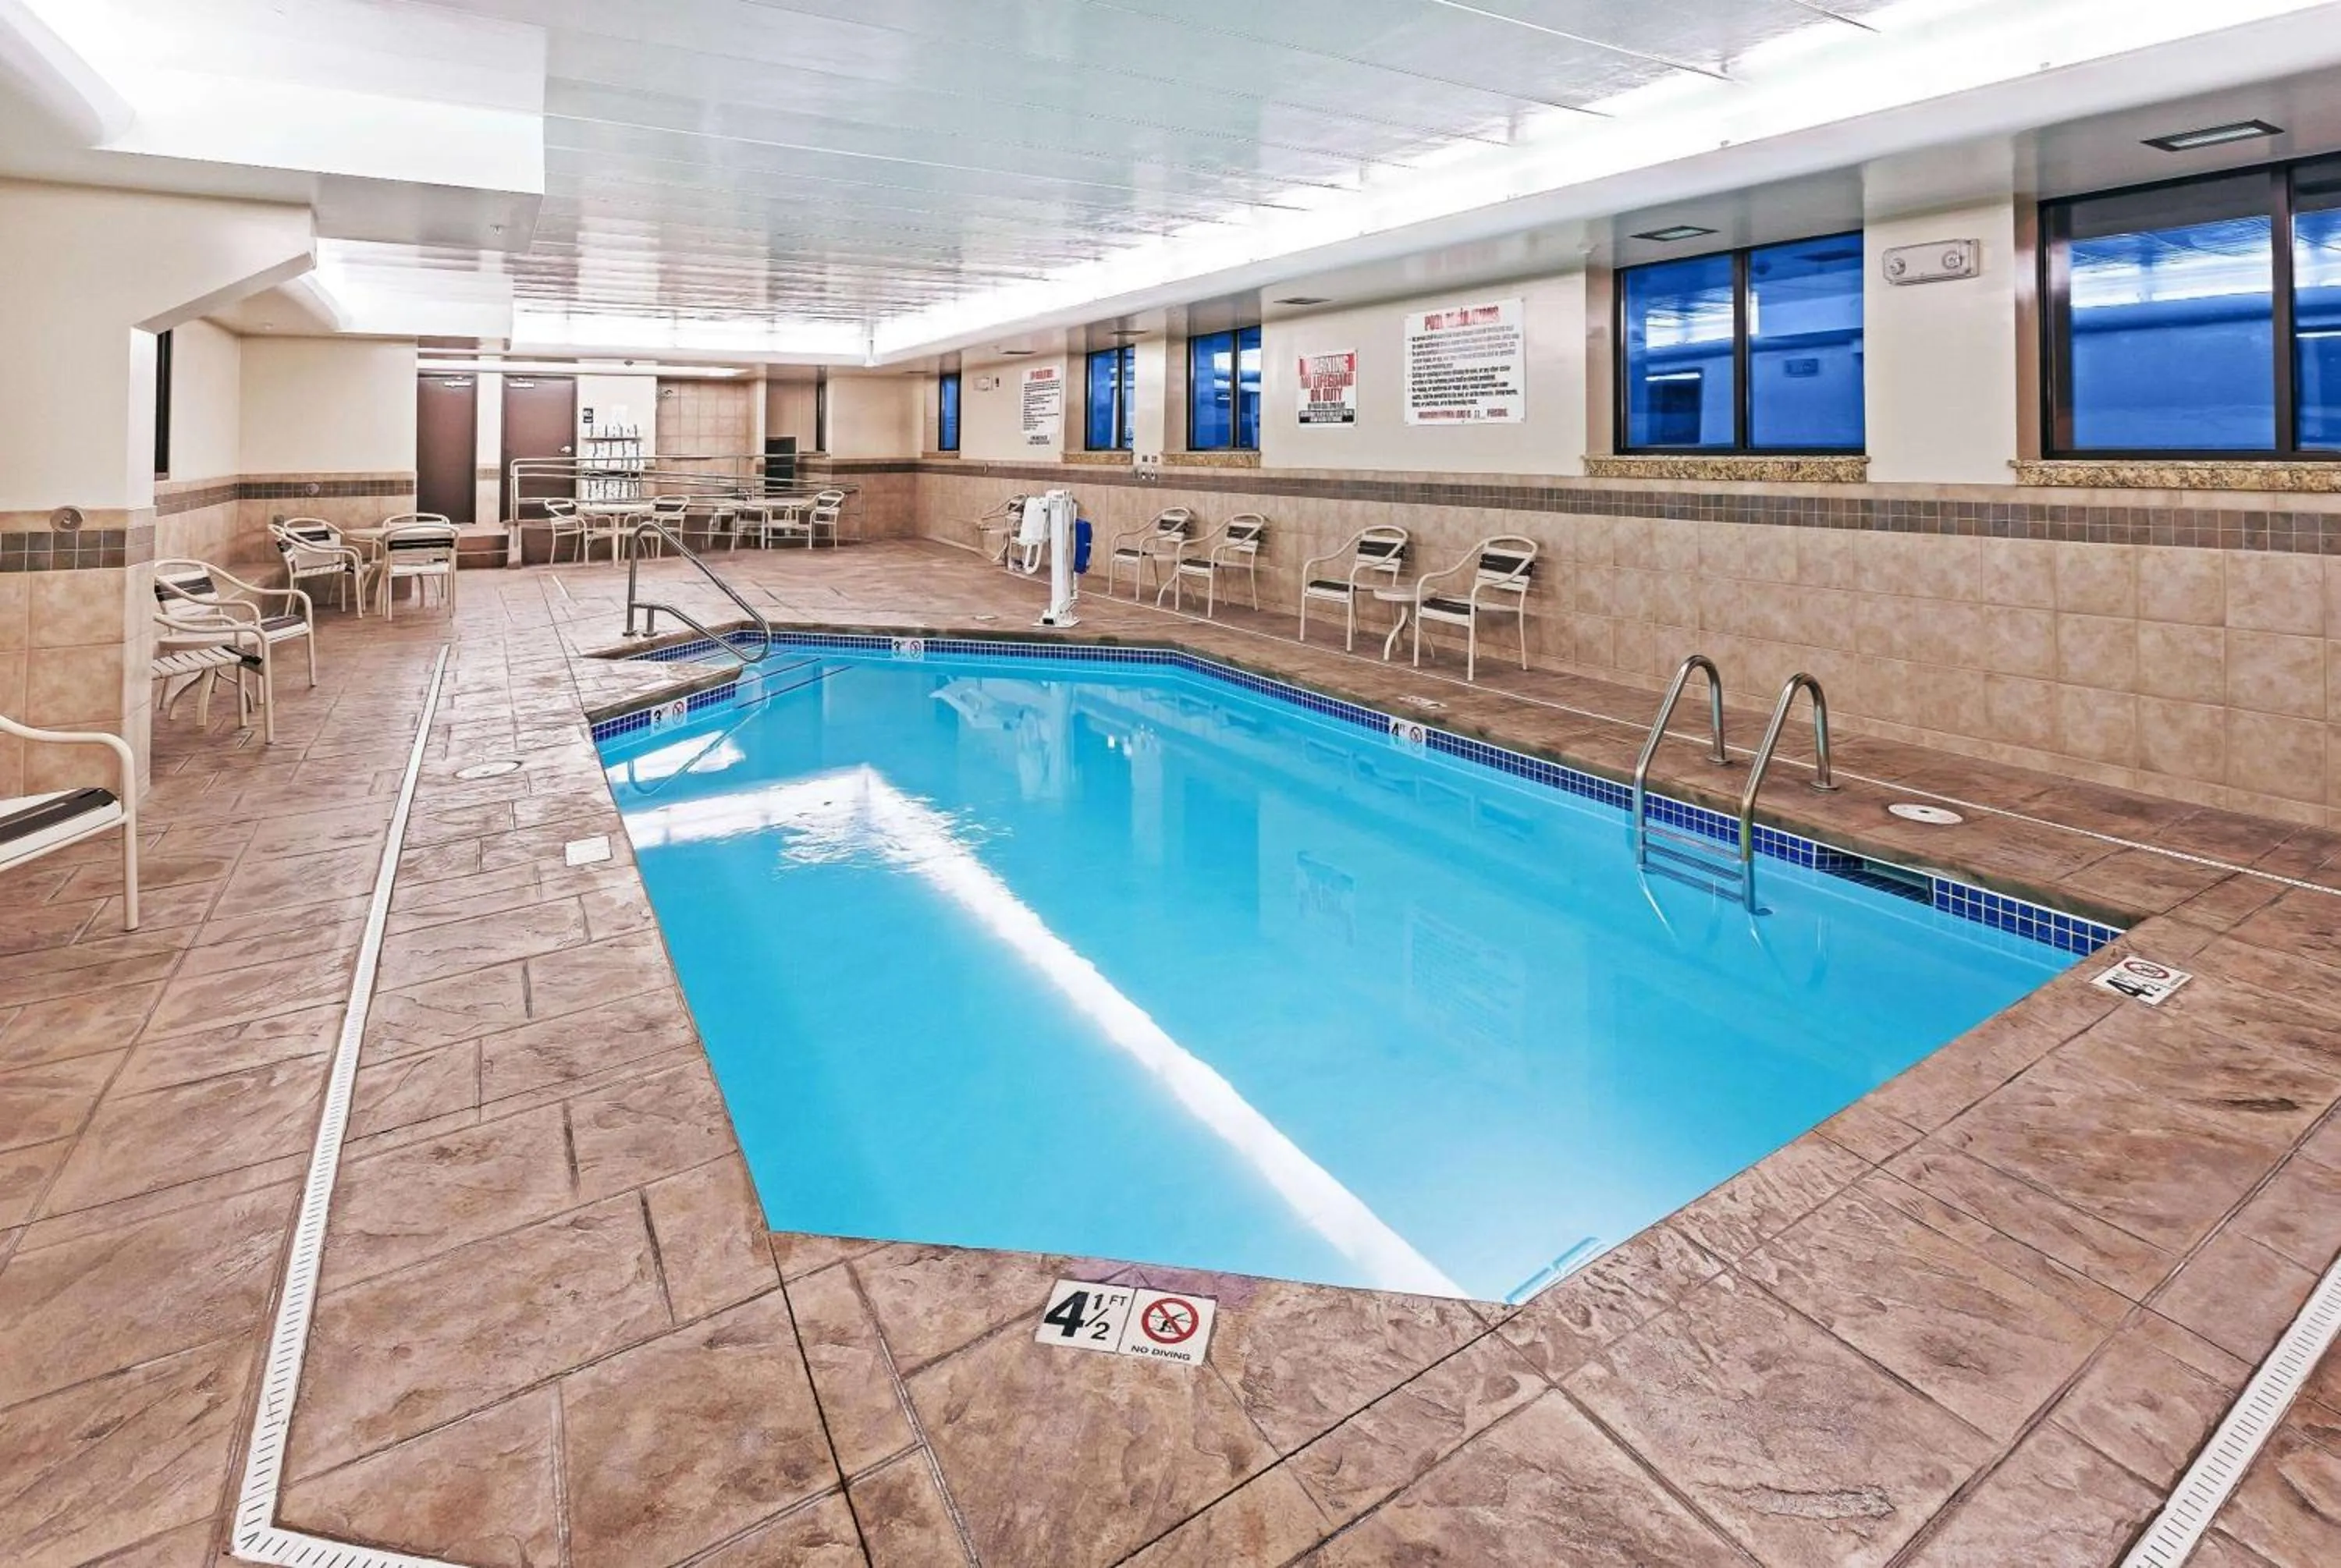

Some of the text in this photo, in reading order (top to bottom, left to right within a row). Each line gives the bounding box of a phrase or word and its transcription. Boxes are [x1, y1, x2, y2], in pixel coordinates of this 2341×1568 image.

[1391, 722, 1399, 737] 4
[2106, 979, 2154, 997] 4
[1043, 1290, 1090, 1338] 4
[1109, 1294, 1128, 1307] FT
[1131, 1345, 1191, 1362] NO DIVING
